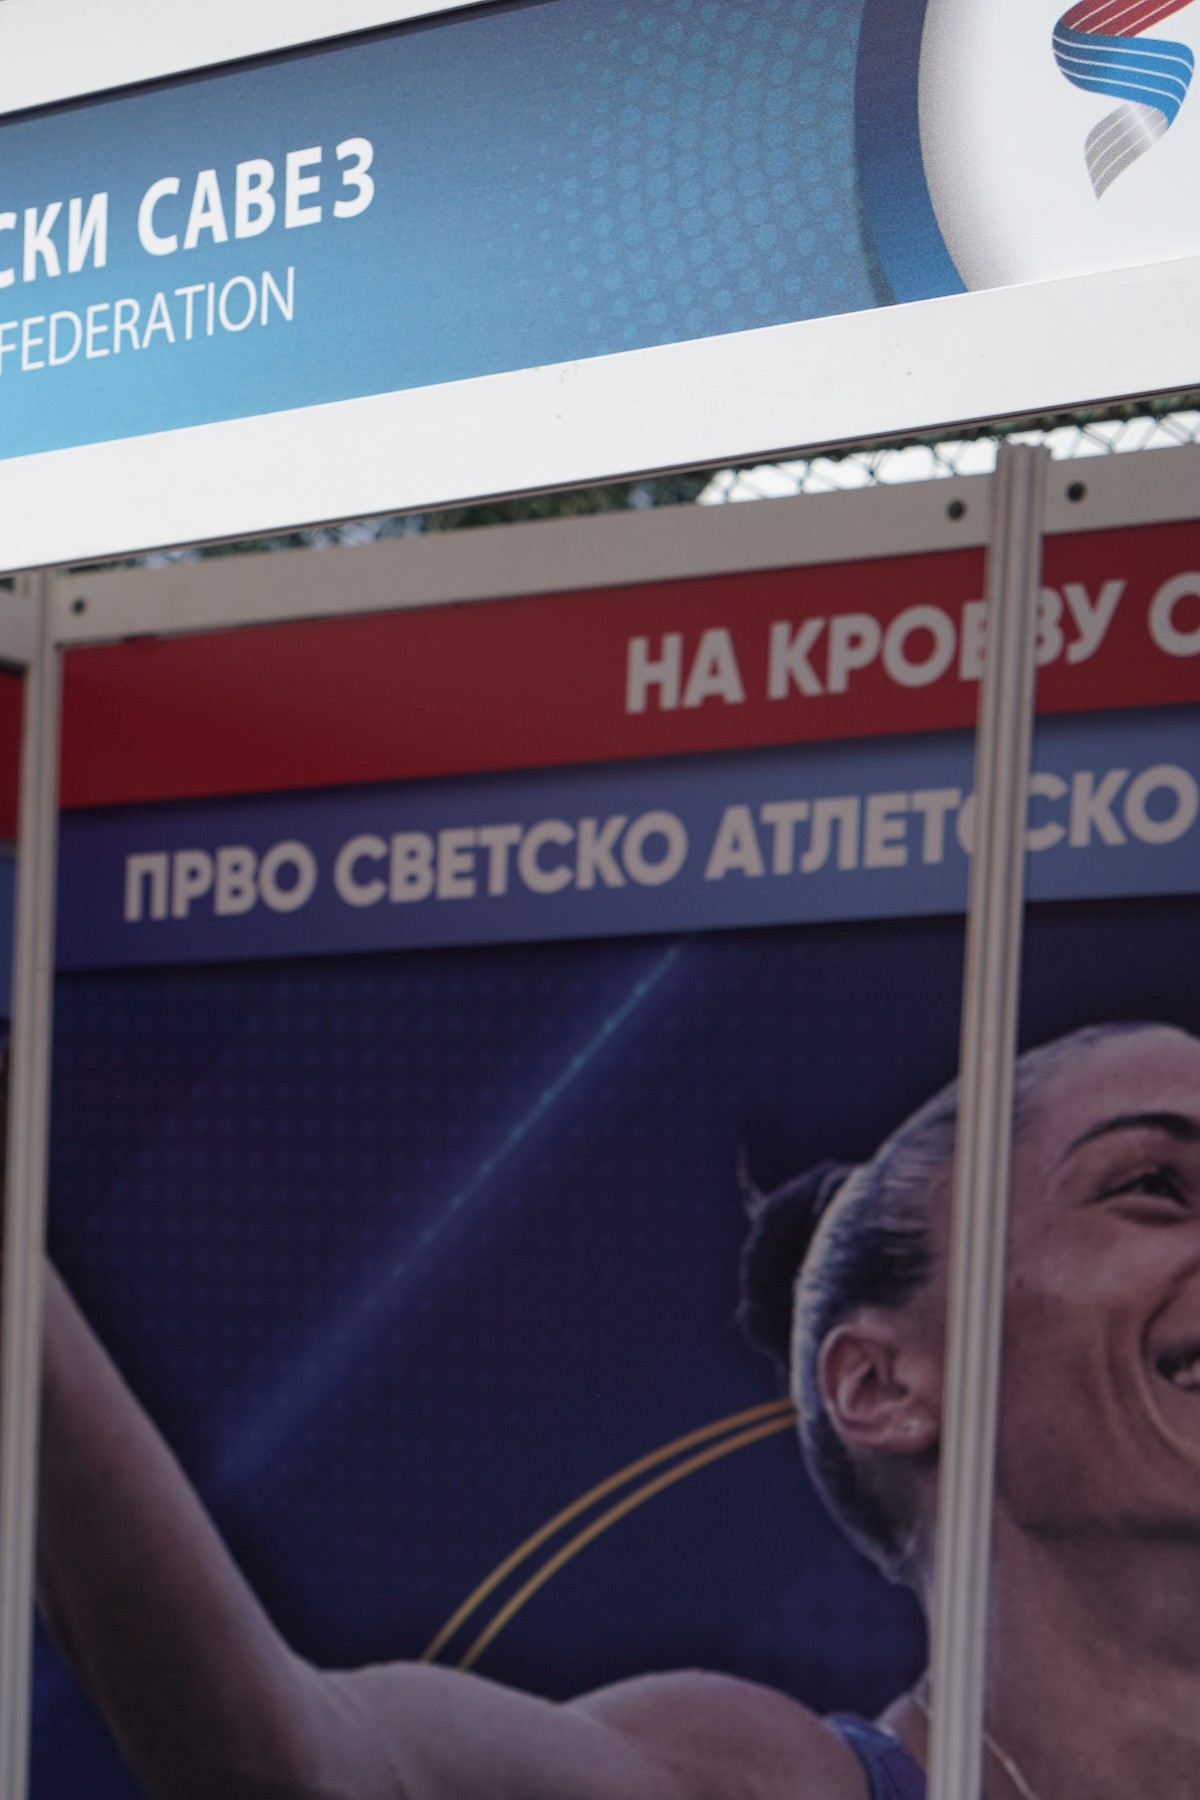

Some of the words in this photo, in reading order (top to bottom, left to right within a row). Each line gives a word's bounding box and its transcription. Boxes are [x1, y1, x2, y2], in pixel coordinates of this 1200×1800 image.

[137, 137, 377, 257] САВЕЗ
[624, 627, 746, 714] НА
[122, 841, 317, 922] ПРВО
[334, 809, 688, 904] СВЕТСКО
